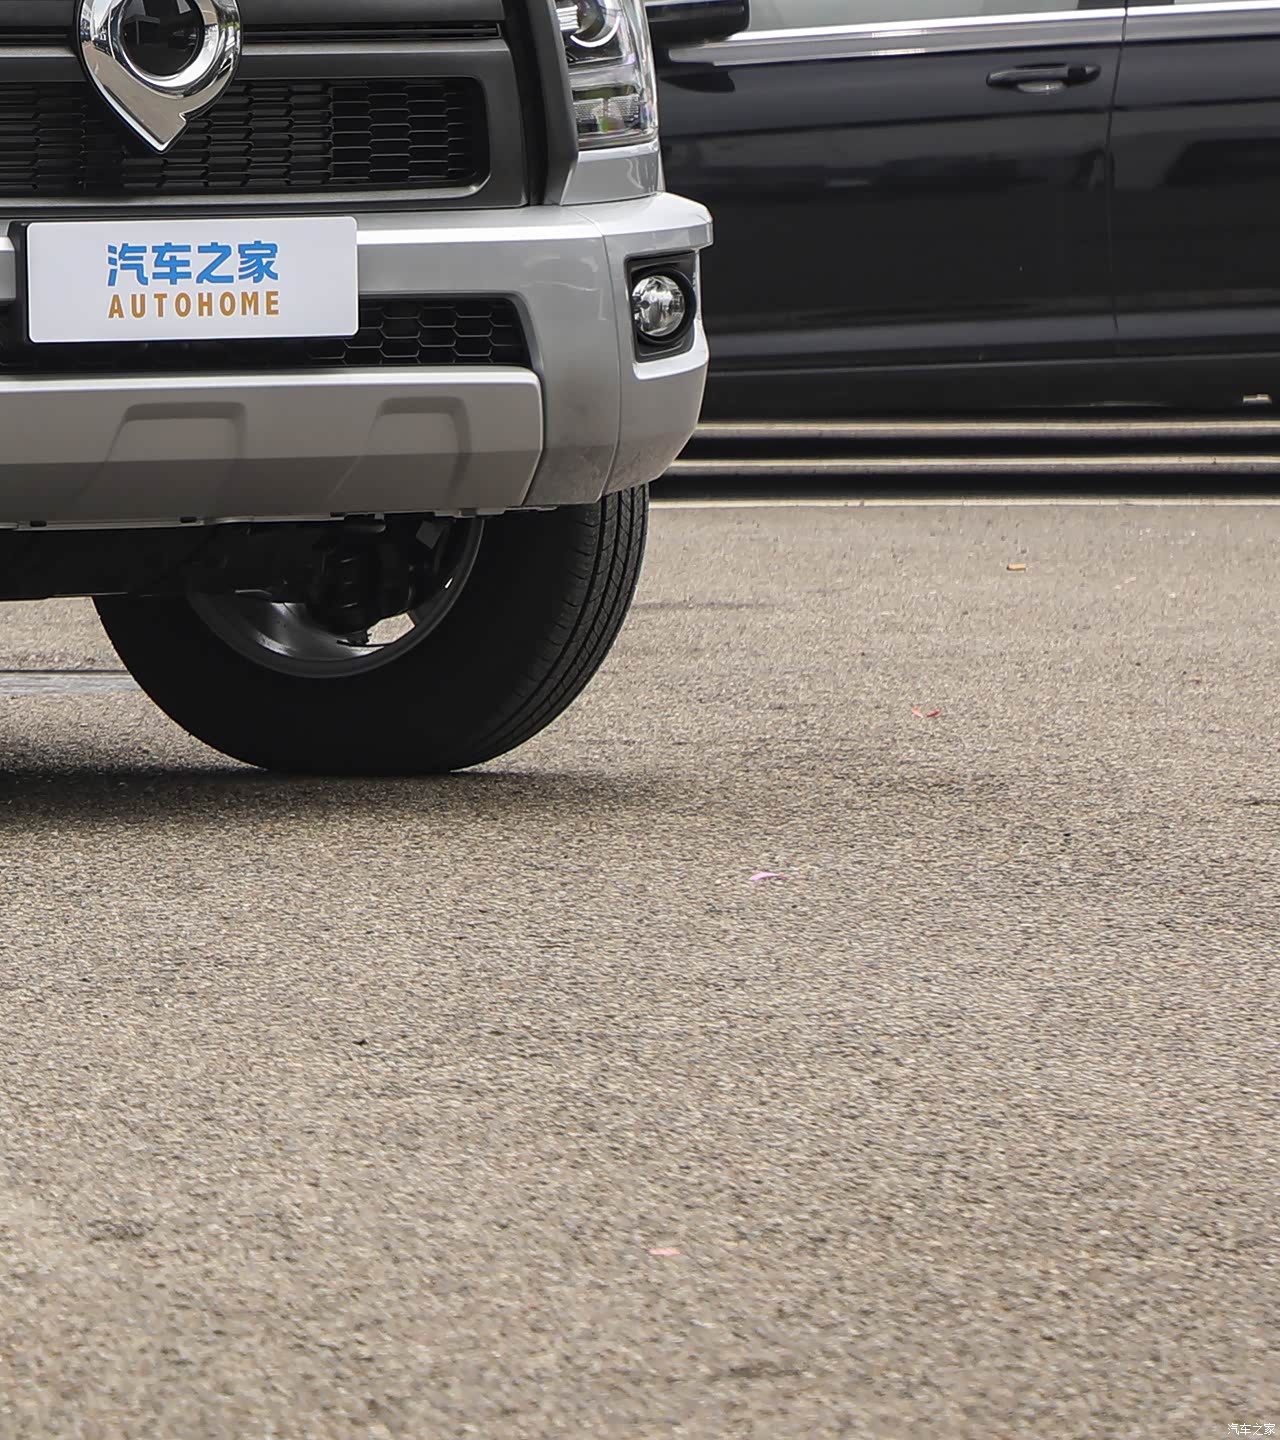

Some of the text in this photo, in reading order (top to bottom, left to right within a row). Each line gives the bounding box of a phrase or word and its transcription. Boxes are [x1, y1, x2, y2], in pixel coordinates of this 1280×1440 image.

[107, 240, 279, 286] 汽车之家
[107, 291, 280, 319] AUTOHOME
